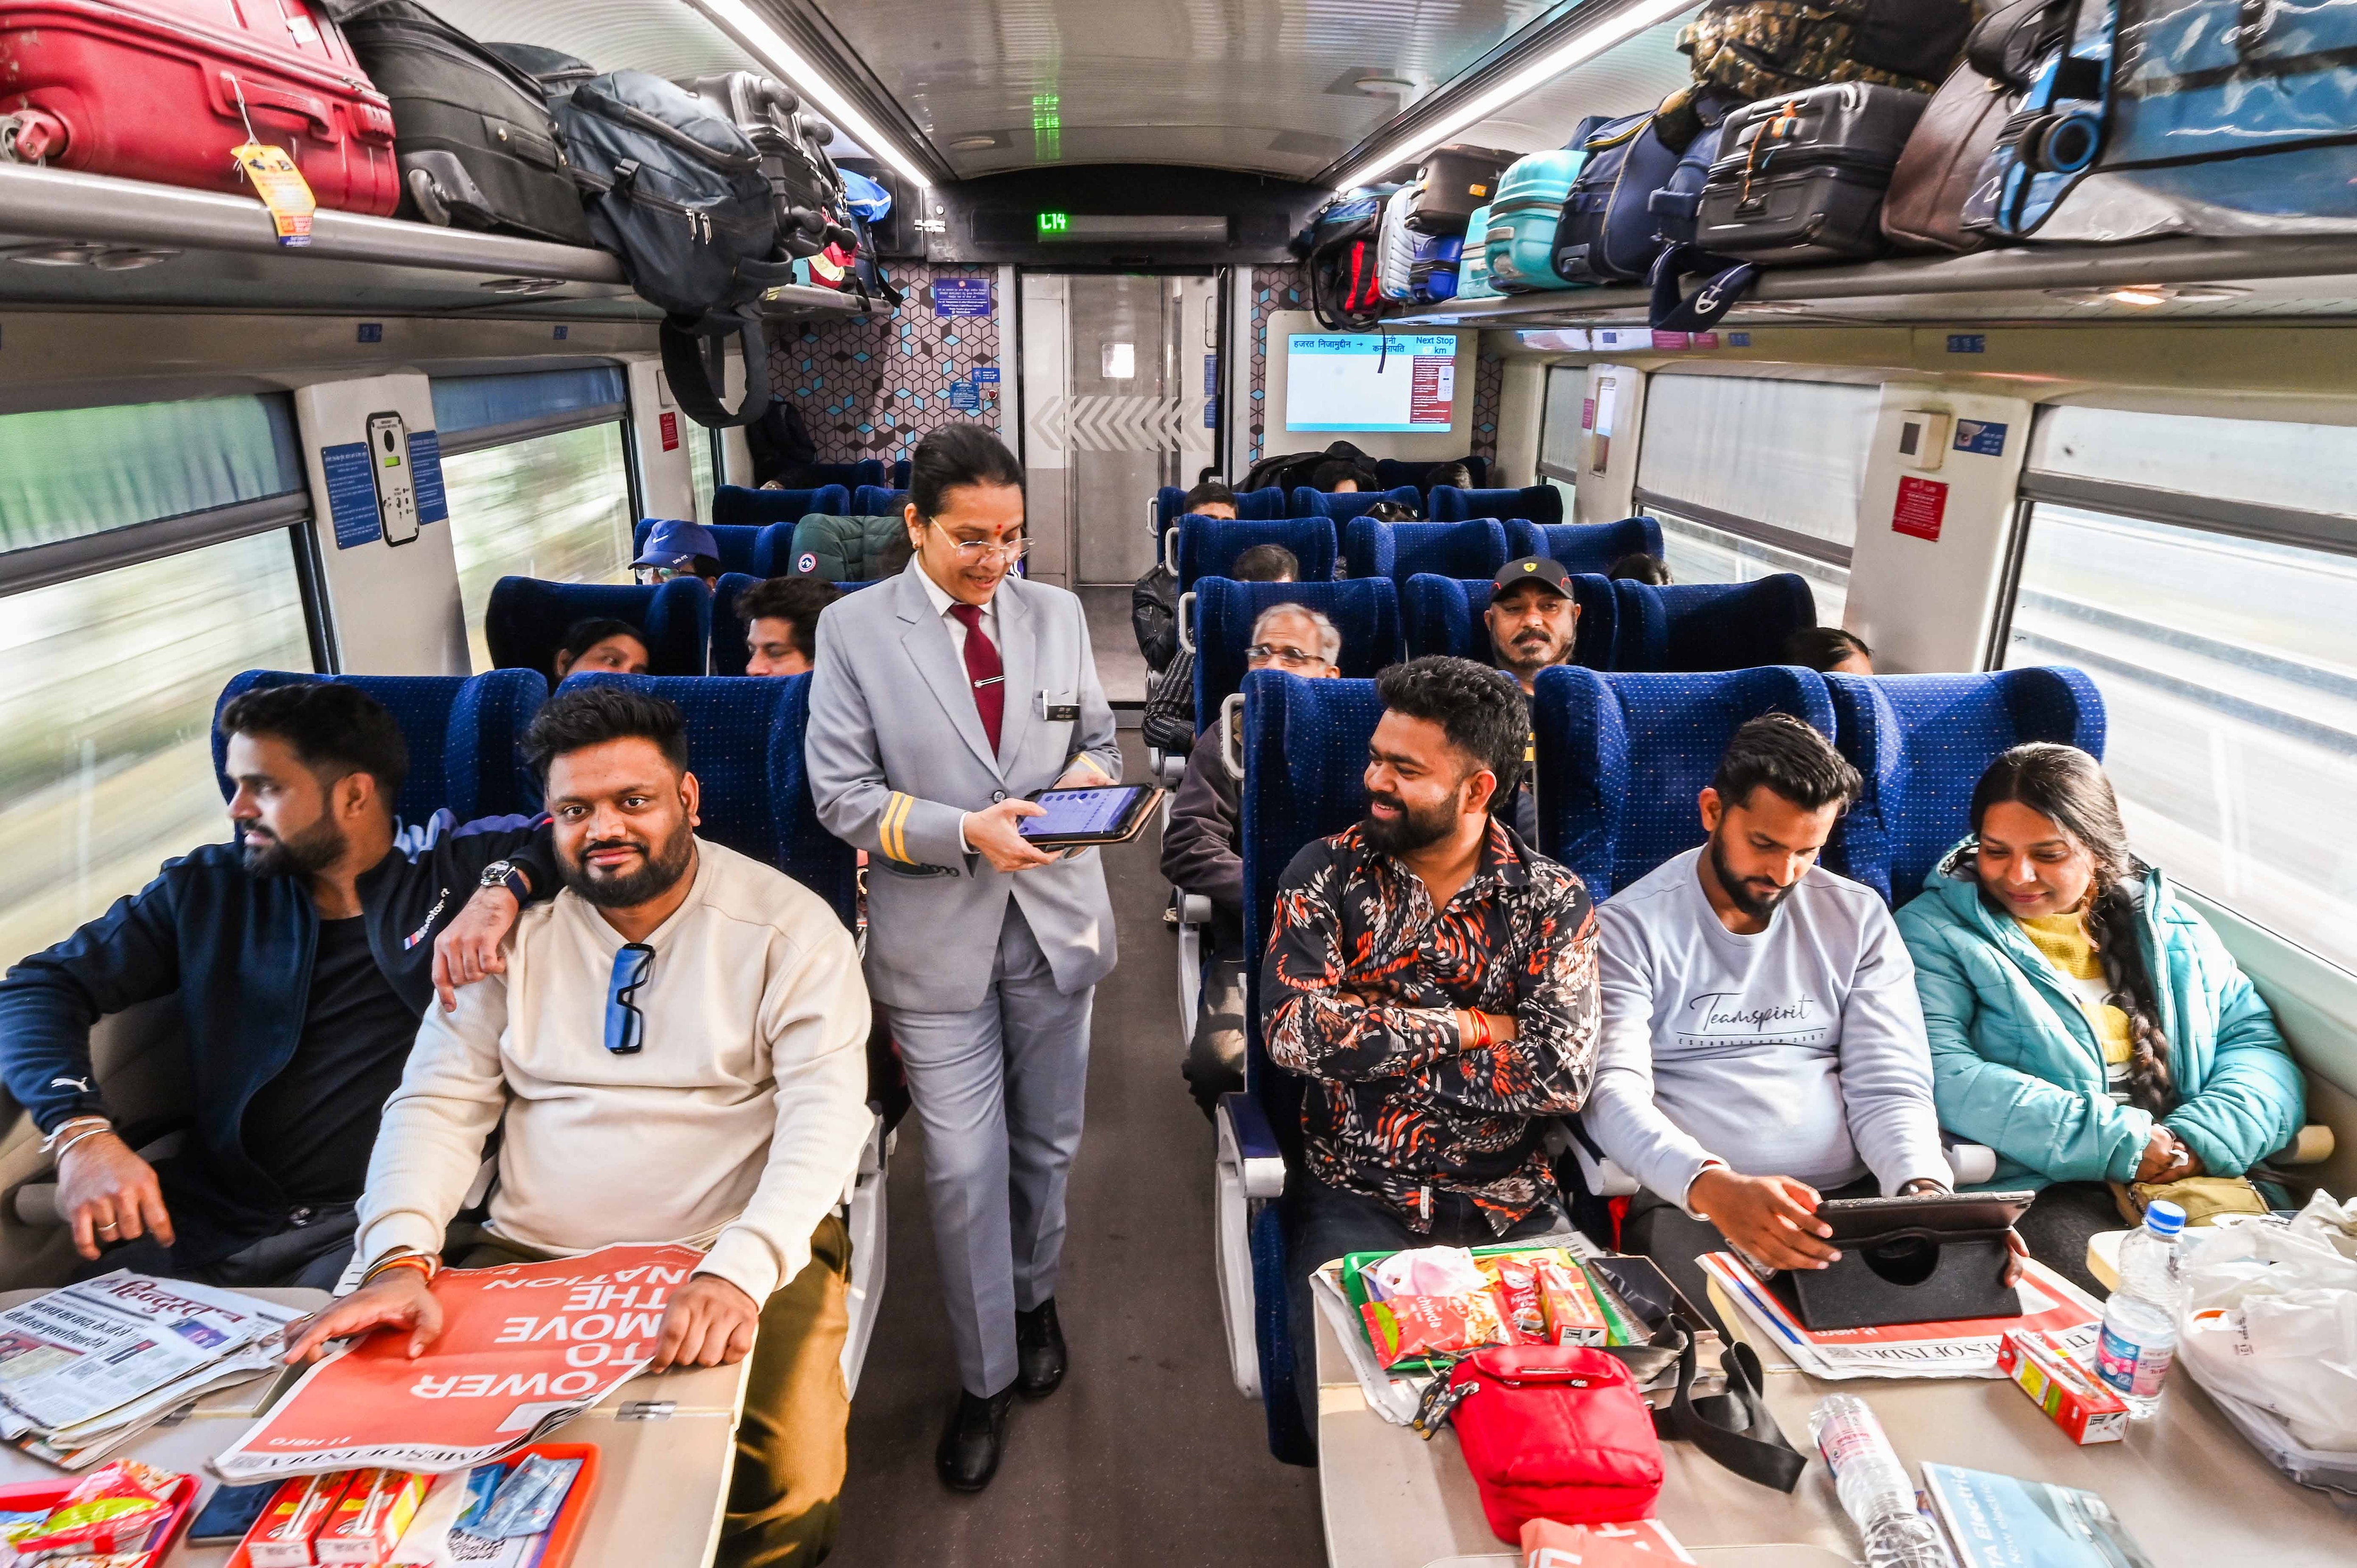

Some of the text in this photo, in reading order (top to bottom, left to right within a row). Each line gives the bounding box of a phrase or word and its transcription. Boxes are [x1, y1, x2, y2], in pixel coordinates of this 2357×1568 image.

[1319, 338, 1351, 350] निजामुद्दीन
[1382, 335, 1396, 344] ानी
[1436, 337, 1454, 346] Stop
[1689, 993, 1814, 1032] Teamspirit
[483, 1265, 688, 1289] NATION
[562, 1285, 668, 1311] THE
[1417, 1296, 1442, 1329] chiwda
[494, 1312, 663, 1344] MOVE
[565, 1341, 644, 1368] TO
[1855, 1347, 1929, 1360] INDIA
[1933, 1345, 1966, 1359] OF
[410, 1370, 609, 1399] OWER
[268, 1437, 327, 1447] Hero
[1950, 1467, 1994, 1541] Electric
